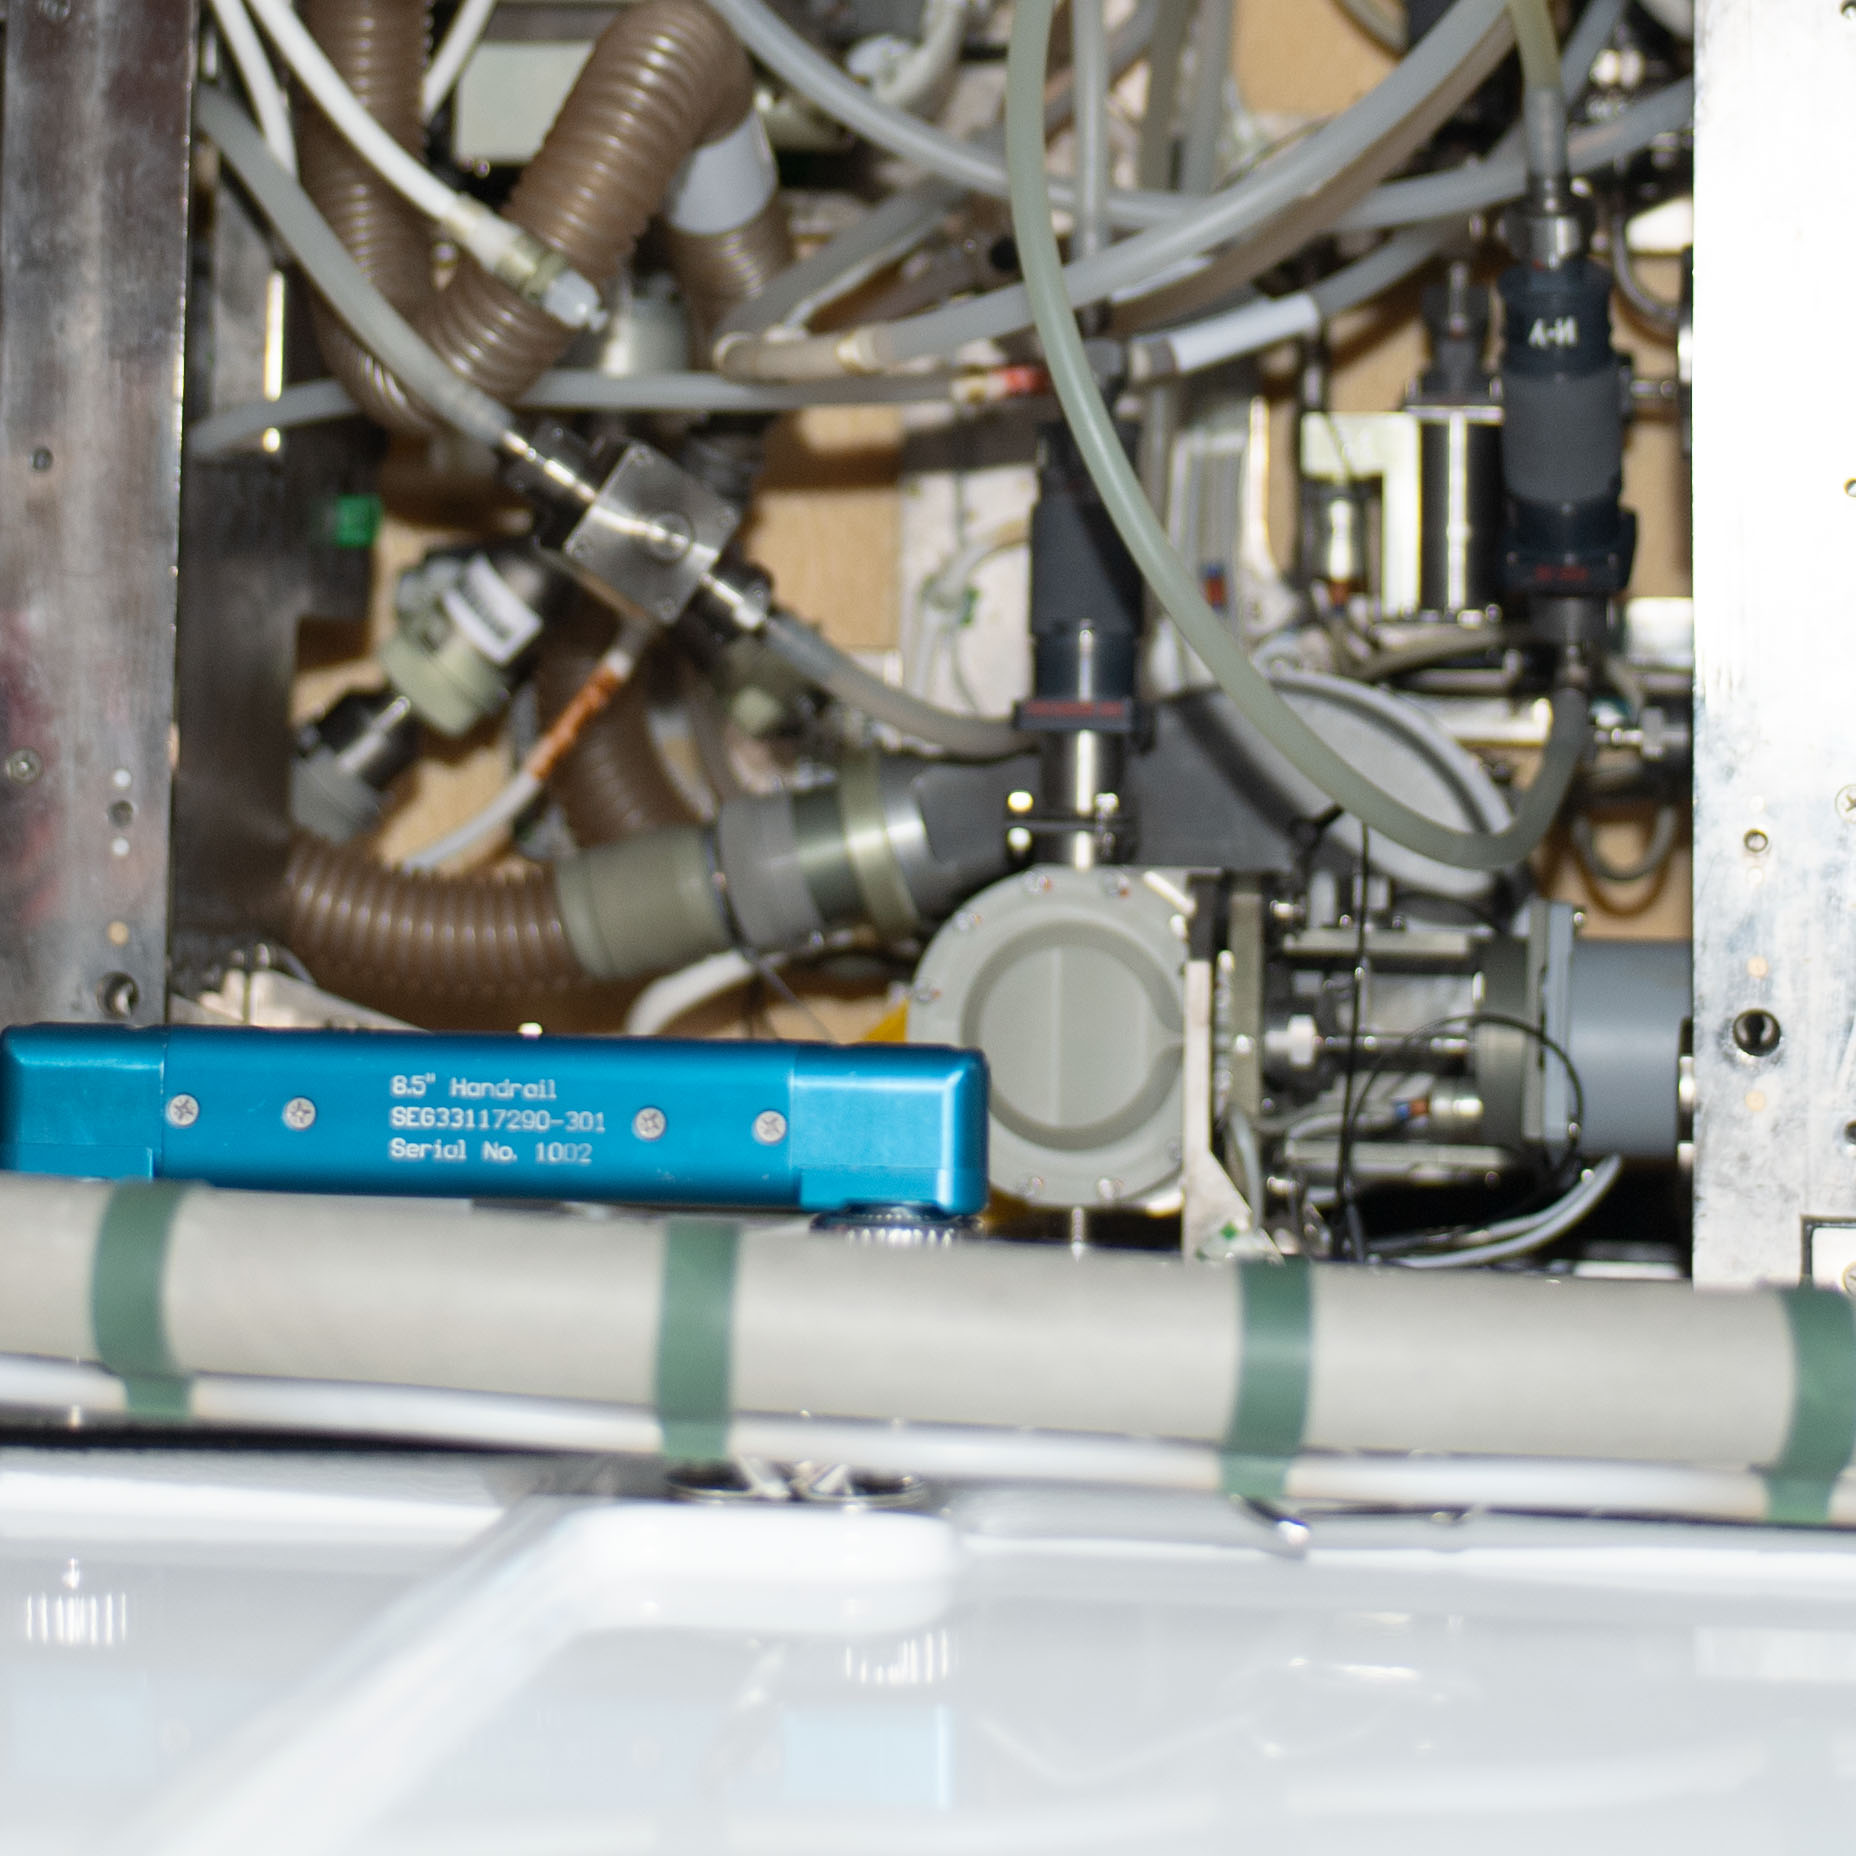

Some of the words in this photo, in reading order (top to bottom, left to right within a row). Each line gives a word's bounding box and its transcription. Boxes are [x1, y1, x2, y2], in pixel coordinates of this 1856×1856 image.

[391, 1072, 436, 1096] 8.5"
[449, 1076, 557, 1101] Handrail
[391, 1107, 605, 1133] SEG33117290-301
[390, 1138, 468, 1161] Serial
[481, 1141, 518, 1162] No.
[535, 1142, 592, 1164] 1002
